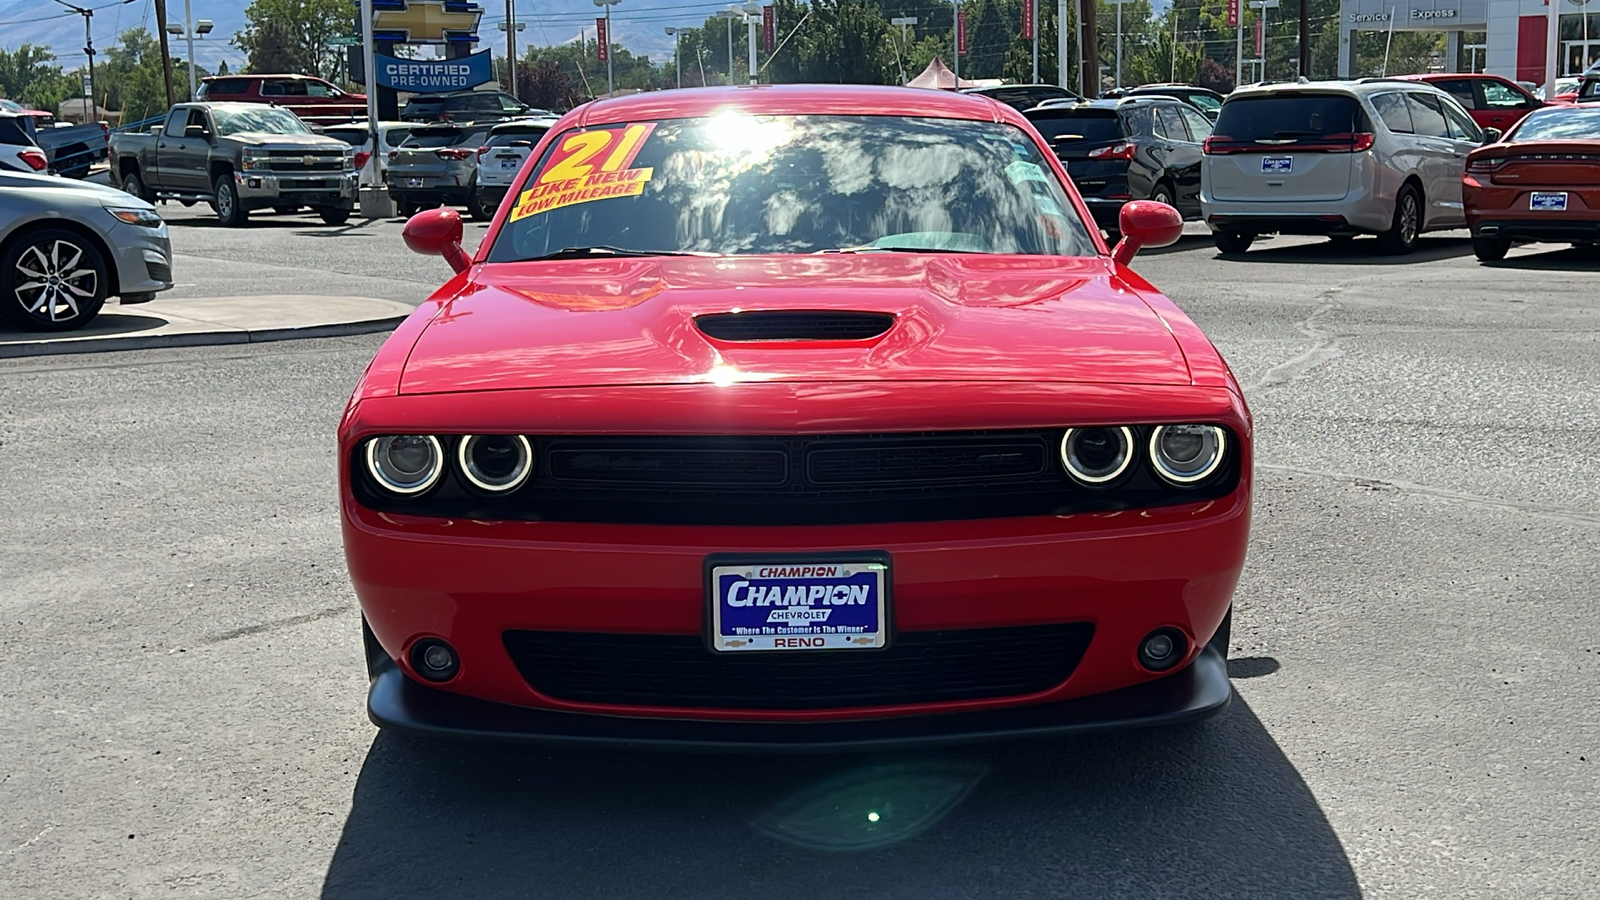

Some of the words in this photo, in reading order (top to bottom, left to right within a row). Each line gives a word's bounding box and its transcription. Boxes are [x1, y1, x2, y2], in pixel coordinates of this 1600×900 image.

[1349, 13, 1389, 23] Service
[1410, 9, 1455, 21] Express
[386, 64, 470, 76] CERTIFIED
[391, 75, 467, 87] PRE-OWNED
[540, 124, 648, 184] 21
[527, 178, 582, 202] LIKE
[583, 169, 644, 187] NEW
[517, 196, 557, 218] LOW
[557, 182, 636, 206] MILEAGE
[759, 566, 837, 578] CHAMPION
[727, 580, 870, 608] CHAMPION
[771, 611, 827, 620] CHEVROLET
[762, 626, 776, 635] The
[777, 626, 812, 635] Customer
[813, 626, 821, 634] Is
[822, 625, 837, 634] The
[774, 637, 825, 648] RENO
